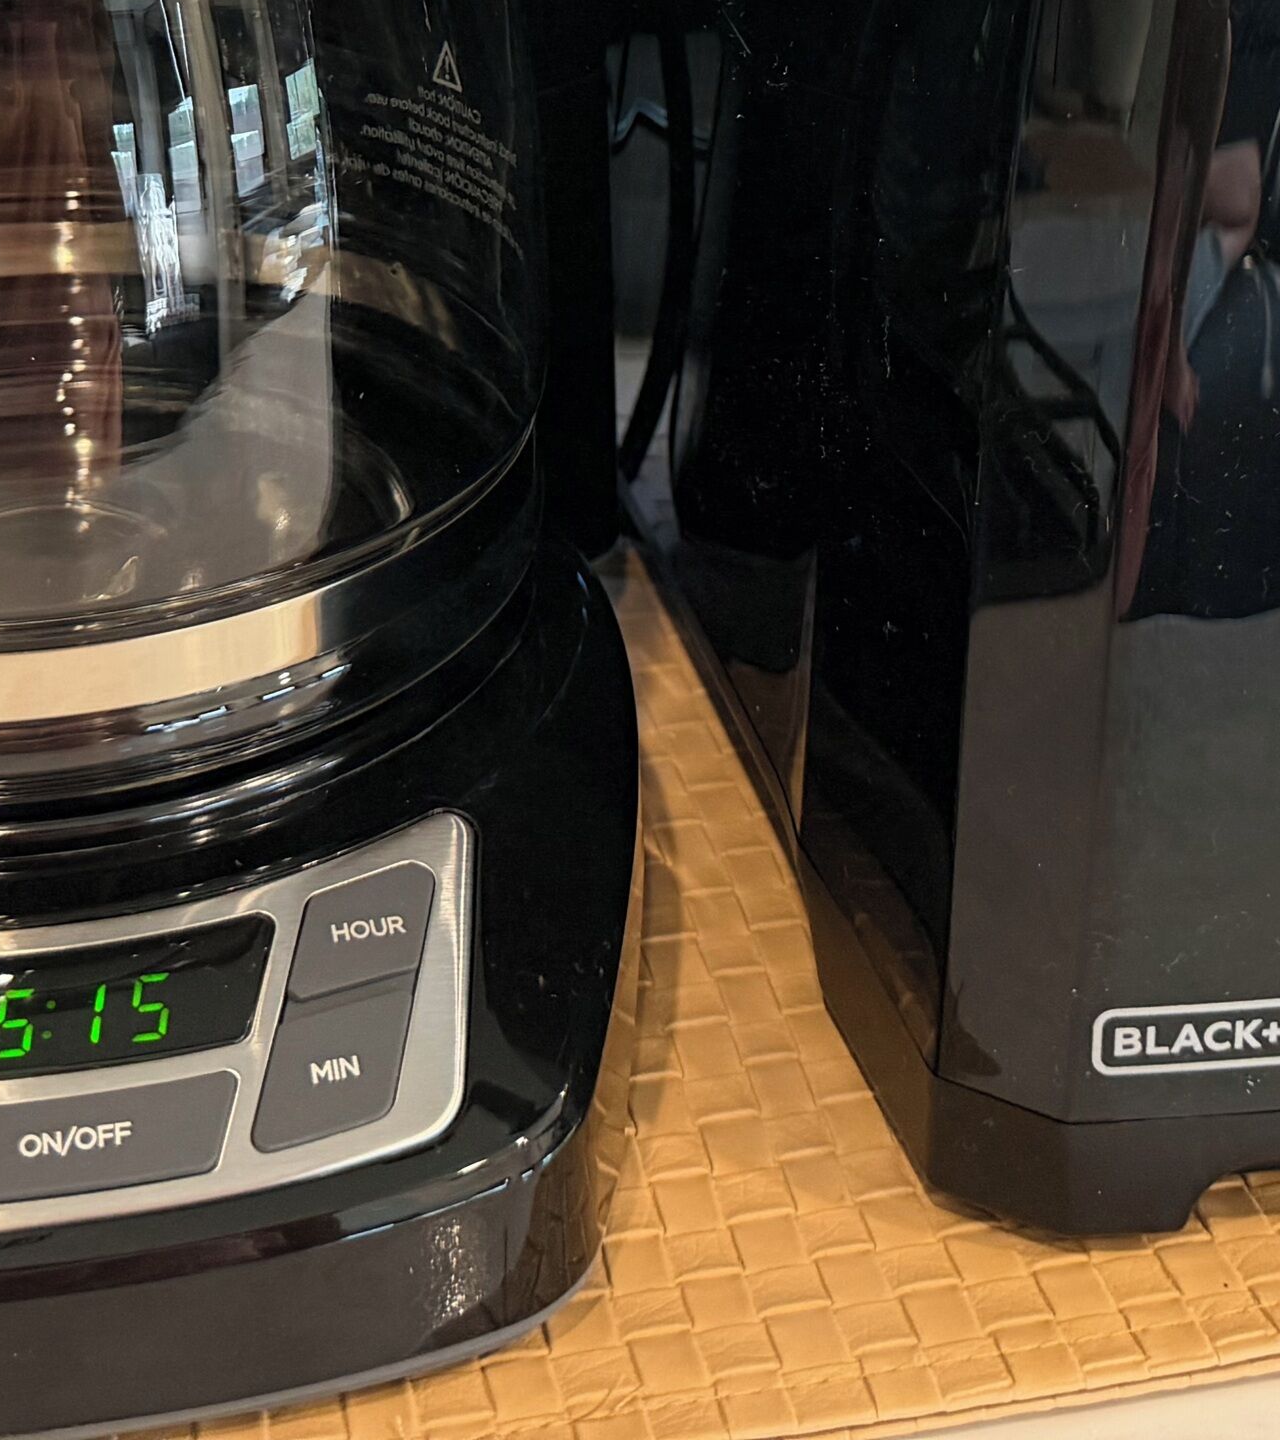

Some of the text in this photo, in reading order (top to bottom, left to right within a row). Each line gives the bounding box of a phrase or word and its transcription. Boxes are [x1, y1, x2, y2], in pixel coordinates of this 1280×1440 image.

[330, 912, 407, 945] HOUR
[309, 1054, 361, 1086] MIN
[18, 1120, 133, 1158] ON/OFF
